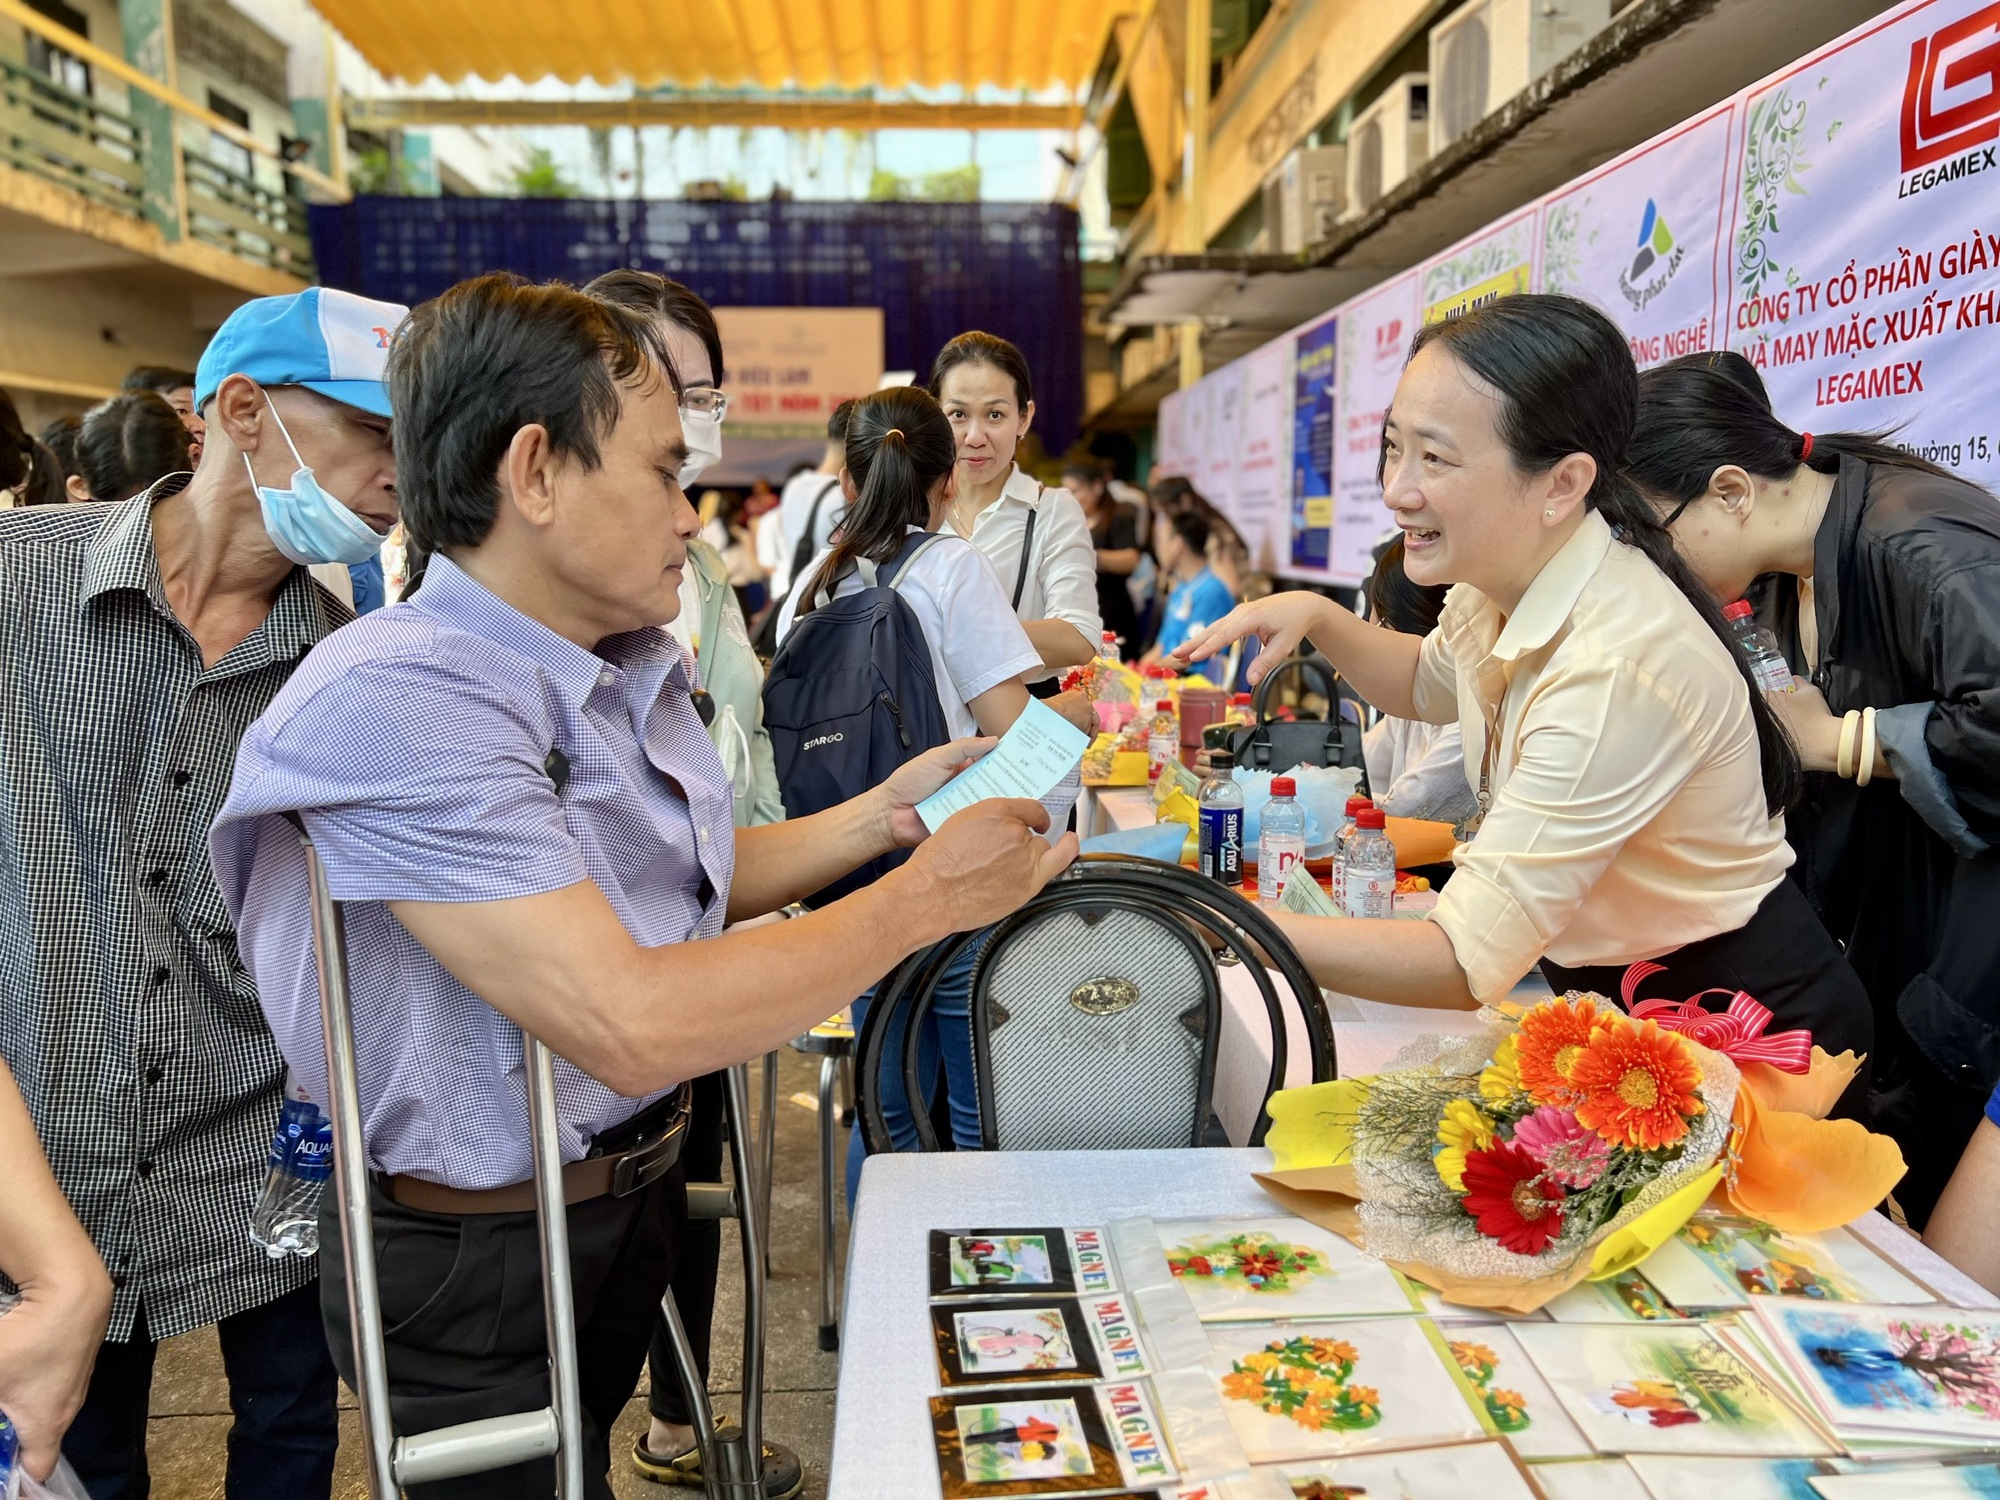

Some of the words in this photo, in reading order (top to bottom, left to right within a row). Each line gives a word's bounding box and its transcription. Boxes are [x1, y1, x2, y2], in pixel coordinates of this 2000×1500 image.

[1898, 146, 1997, 200] LEGAMEX
[1736, 292, 1790, 330] CÔNG
[1795, 282, 1821, 316] TY
[1826, 258, 1858, 308] CỔ
[1863, 246, 1932, 300] PHẦN
[1938, 229, 2000, 280] GIÀY
[1630, 335, 1660, 364] ÔNG
[1742, 335, 1768, 370] VÀ
[1772, 329, 1819, 368] MAY
[1823, 311, 1877, 359] MẶC
[1883, 289, 1953, 346] XUẤT
[1816, 360, 1924, 407] LEGAMEX
[1967, 435, 1992, 463] 15,
[803, 732, 844, 751] STARGO
[1221, 813, 1241, 873] AQUARIUS
[1073, 1230, 1110, 1292] MAGNET
[1094, 1300, 1146, 1373] MAGNET
[1107, 1384, 1168, 1476] MAGNET
